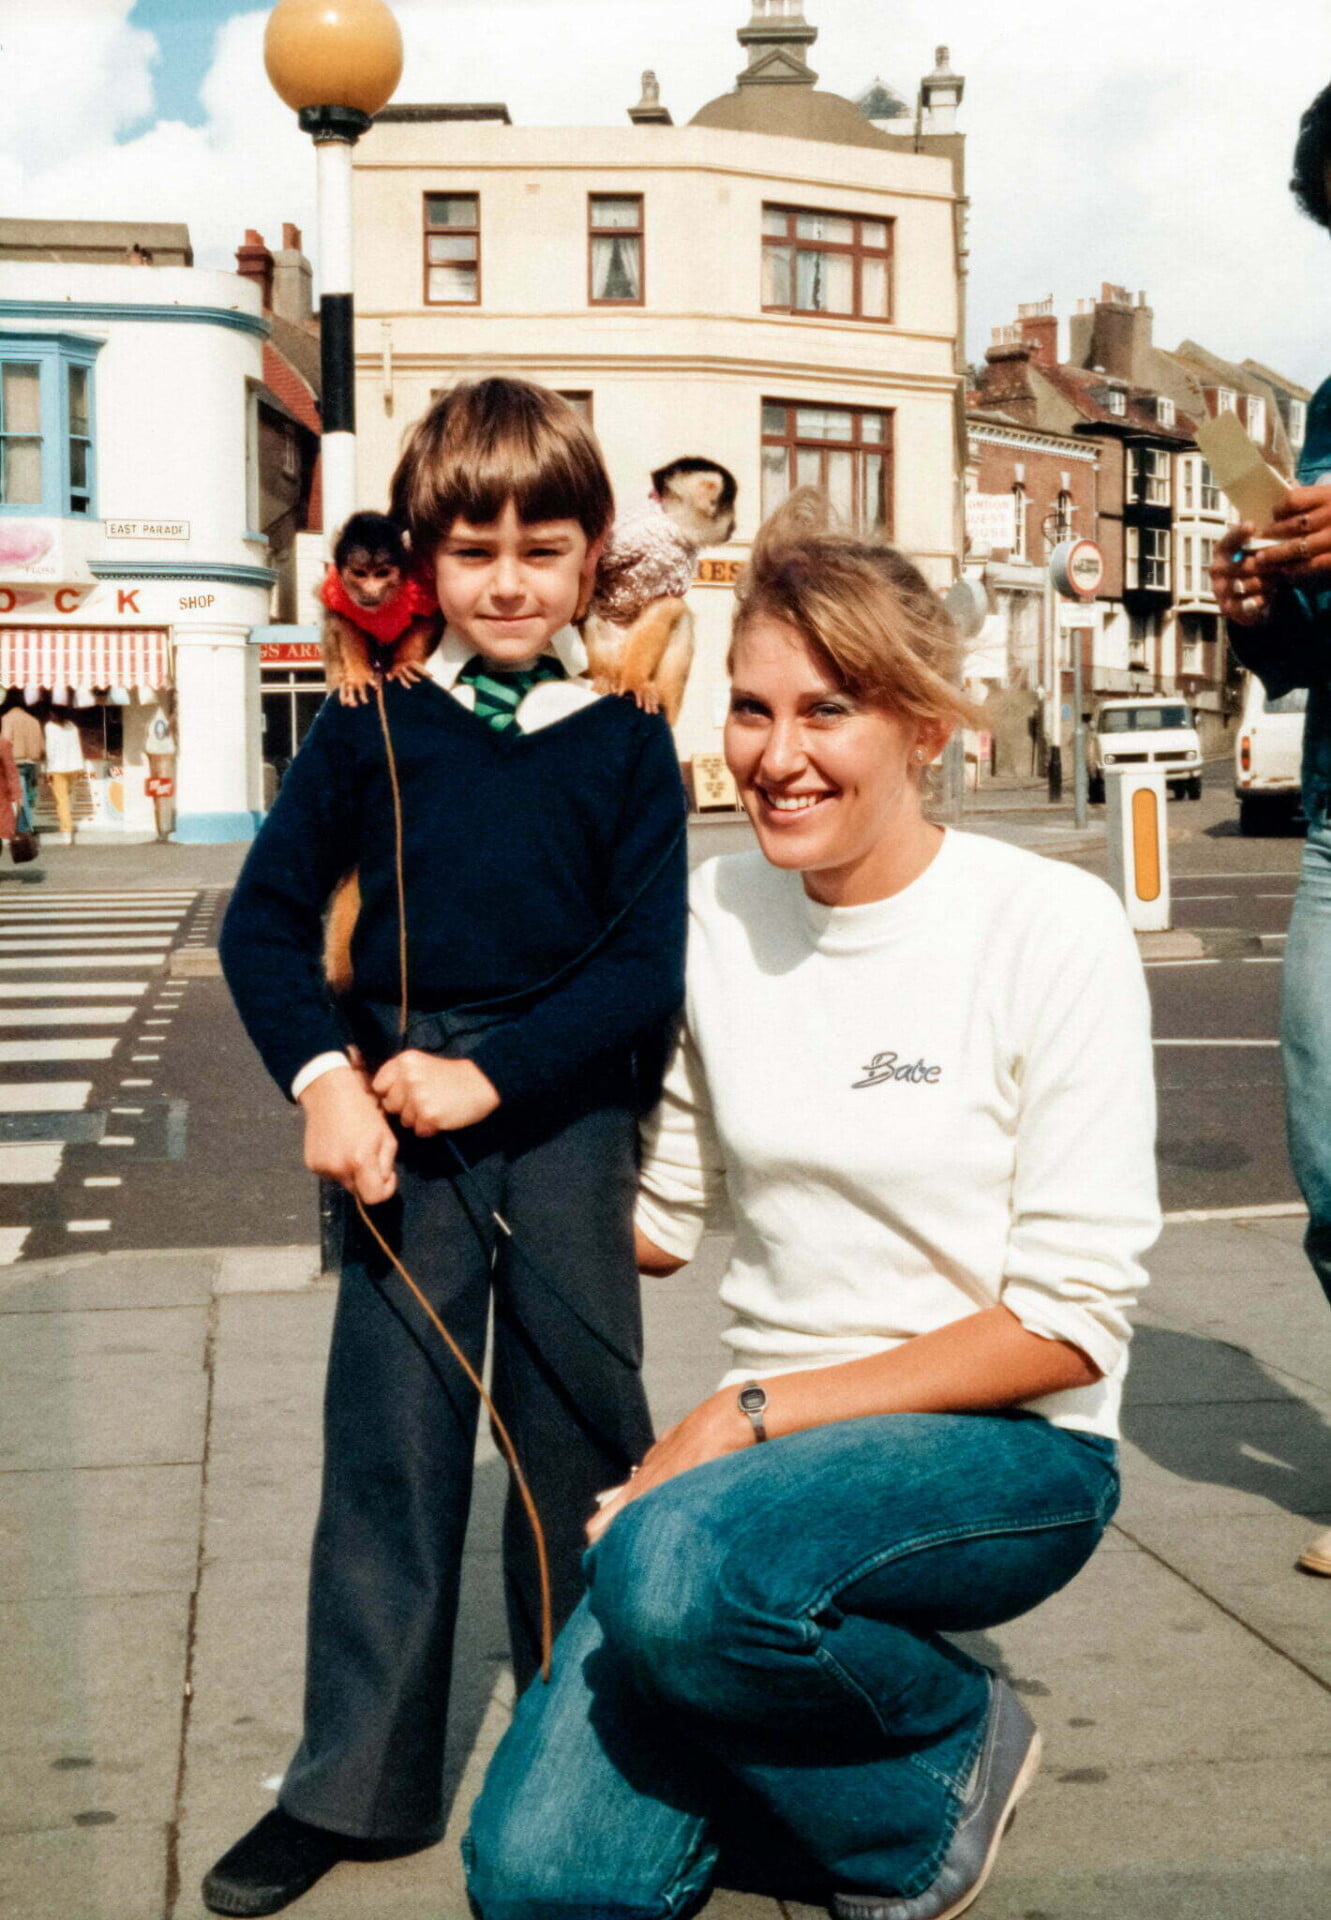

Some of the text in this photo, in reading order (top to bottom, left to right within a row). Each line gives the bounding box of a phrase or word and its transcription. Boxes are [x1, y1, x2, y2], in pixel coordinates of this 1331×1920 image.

[110, 523, 183, 535] EAST PARADE
[698, 561, 744, 580] ES
[179, 594, 216, 610] SHOP
[851, 1051, 942, 1089] Babe
